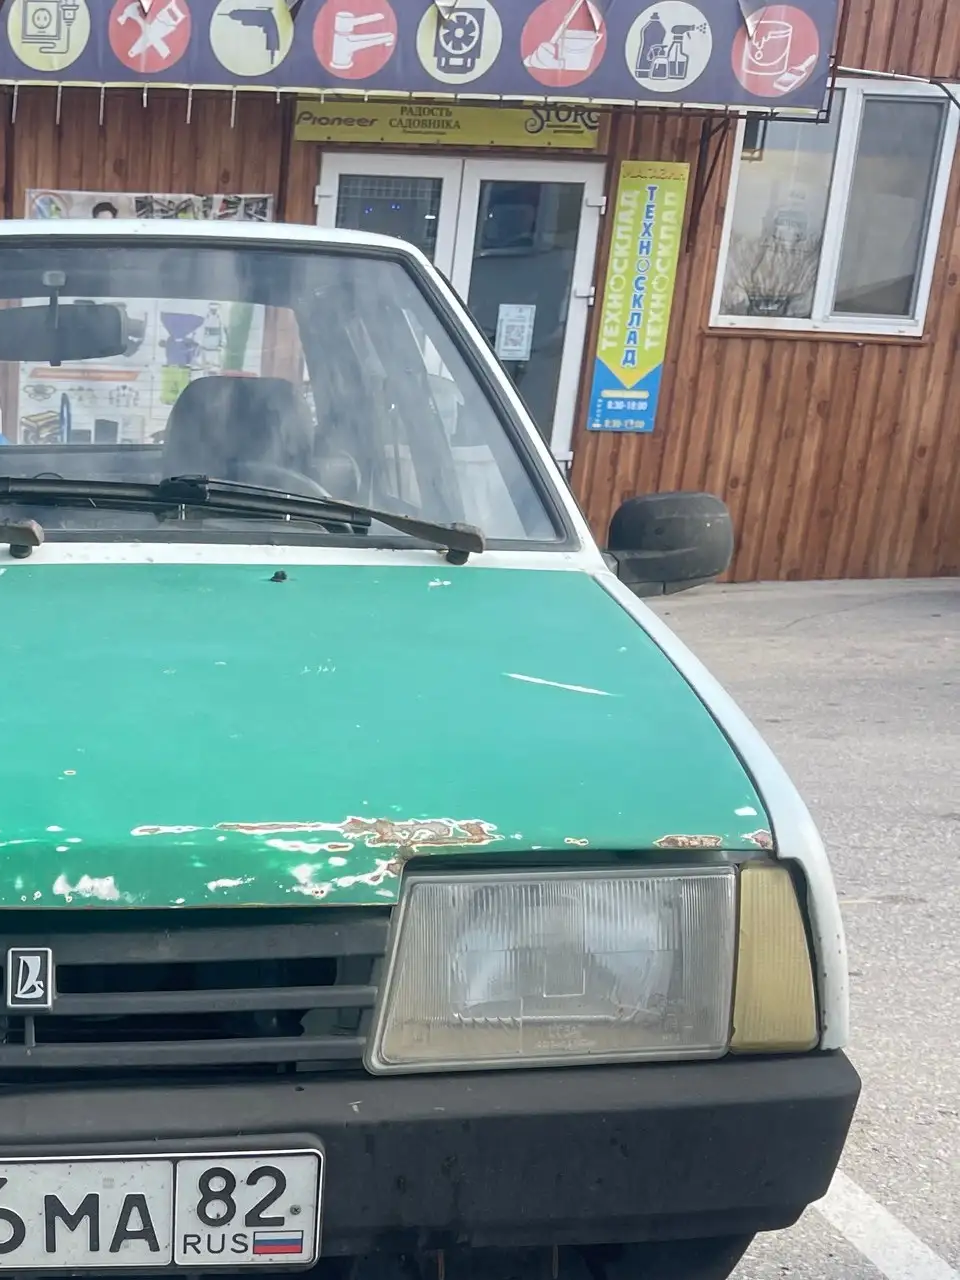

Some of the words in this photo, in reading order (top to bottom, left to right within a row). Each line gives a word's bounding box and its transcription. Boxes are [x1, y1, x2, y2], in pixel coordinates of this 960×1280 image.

[296, 111, 378, 127] Pioneer
[389, 117, 461, 130] САДОВНИКА
[400, 106, 453, 118] РАДОСТЬ
[600, 189, 641, 352] ТЕХНОСКЛАД
[620, 185, 659, 367] ТЕХНОСКЛАД
[196, 1166, 287, 1227] 82
[182, 1232, 249, 1255] RUS
